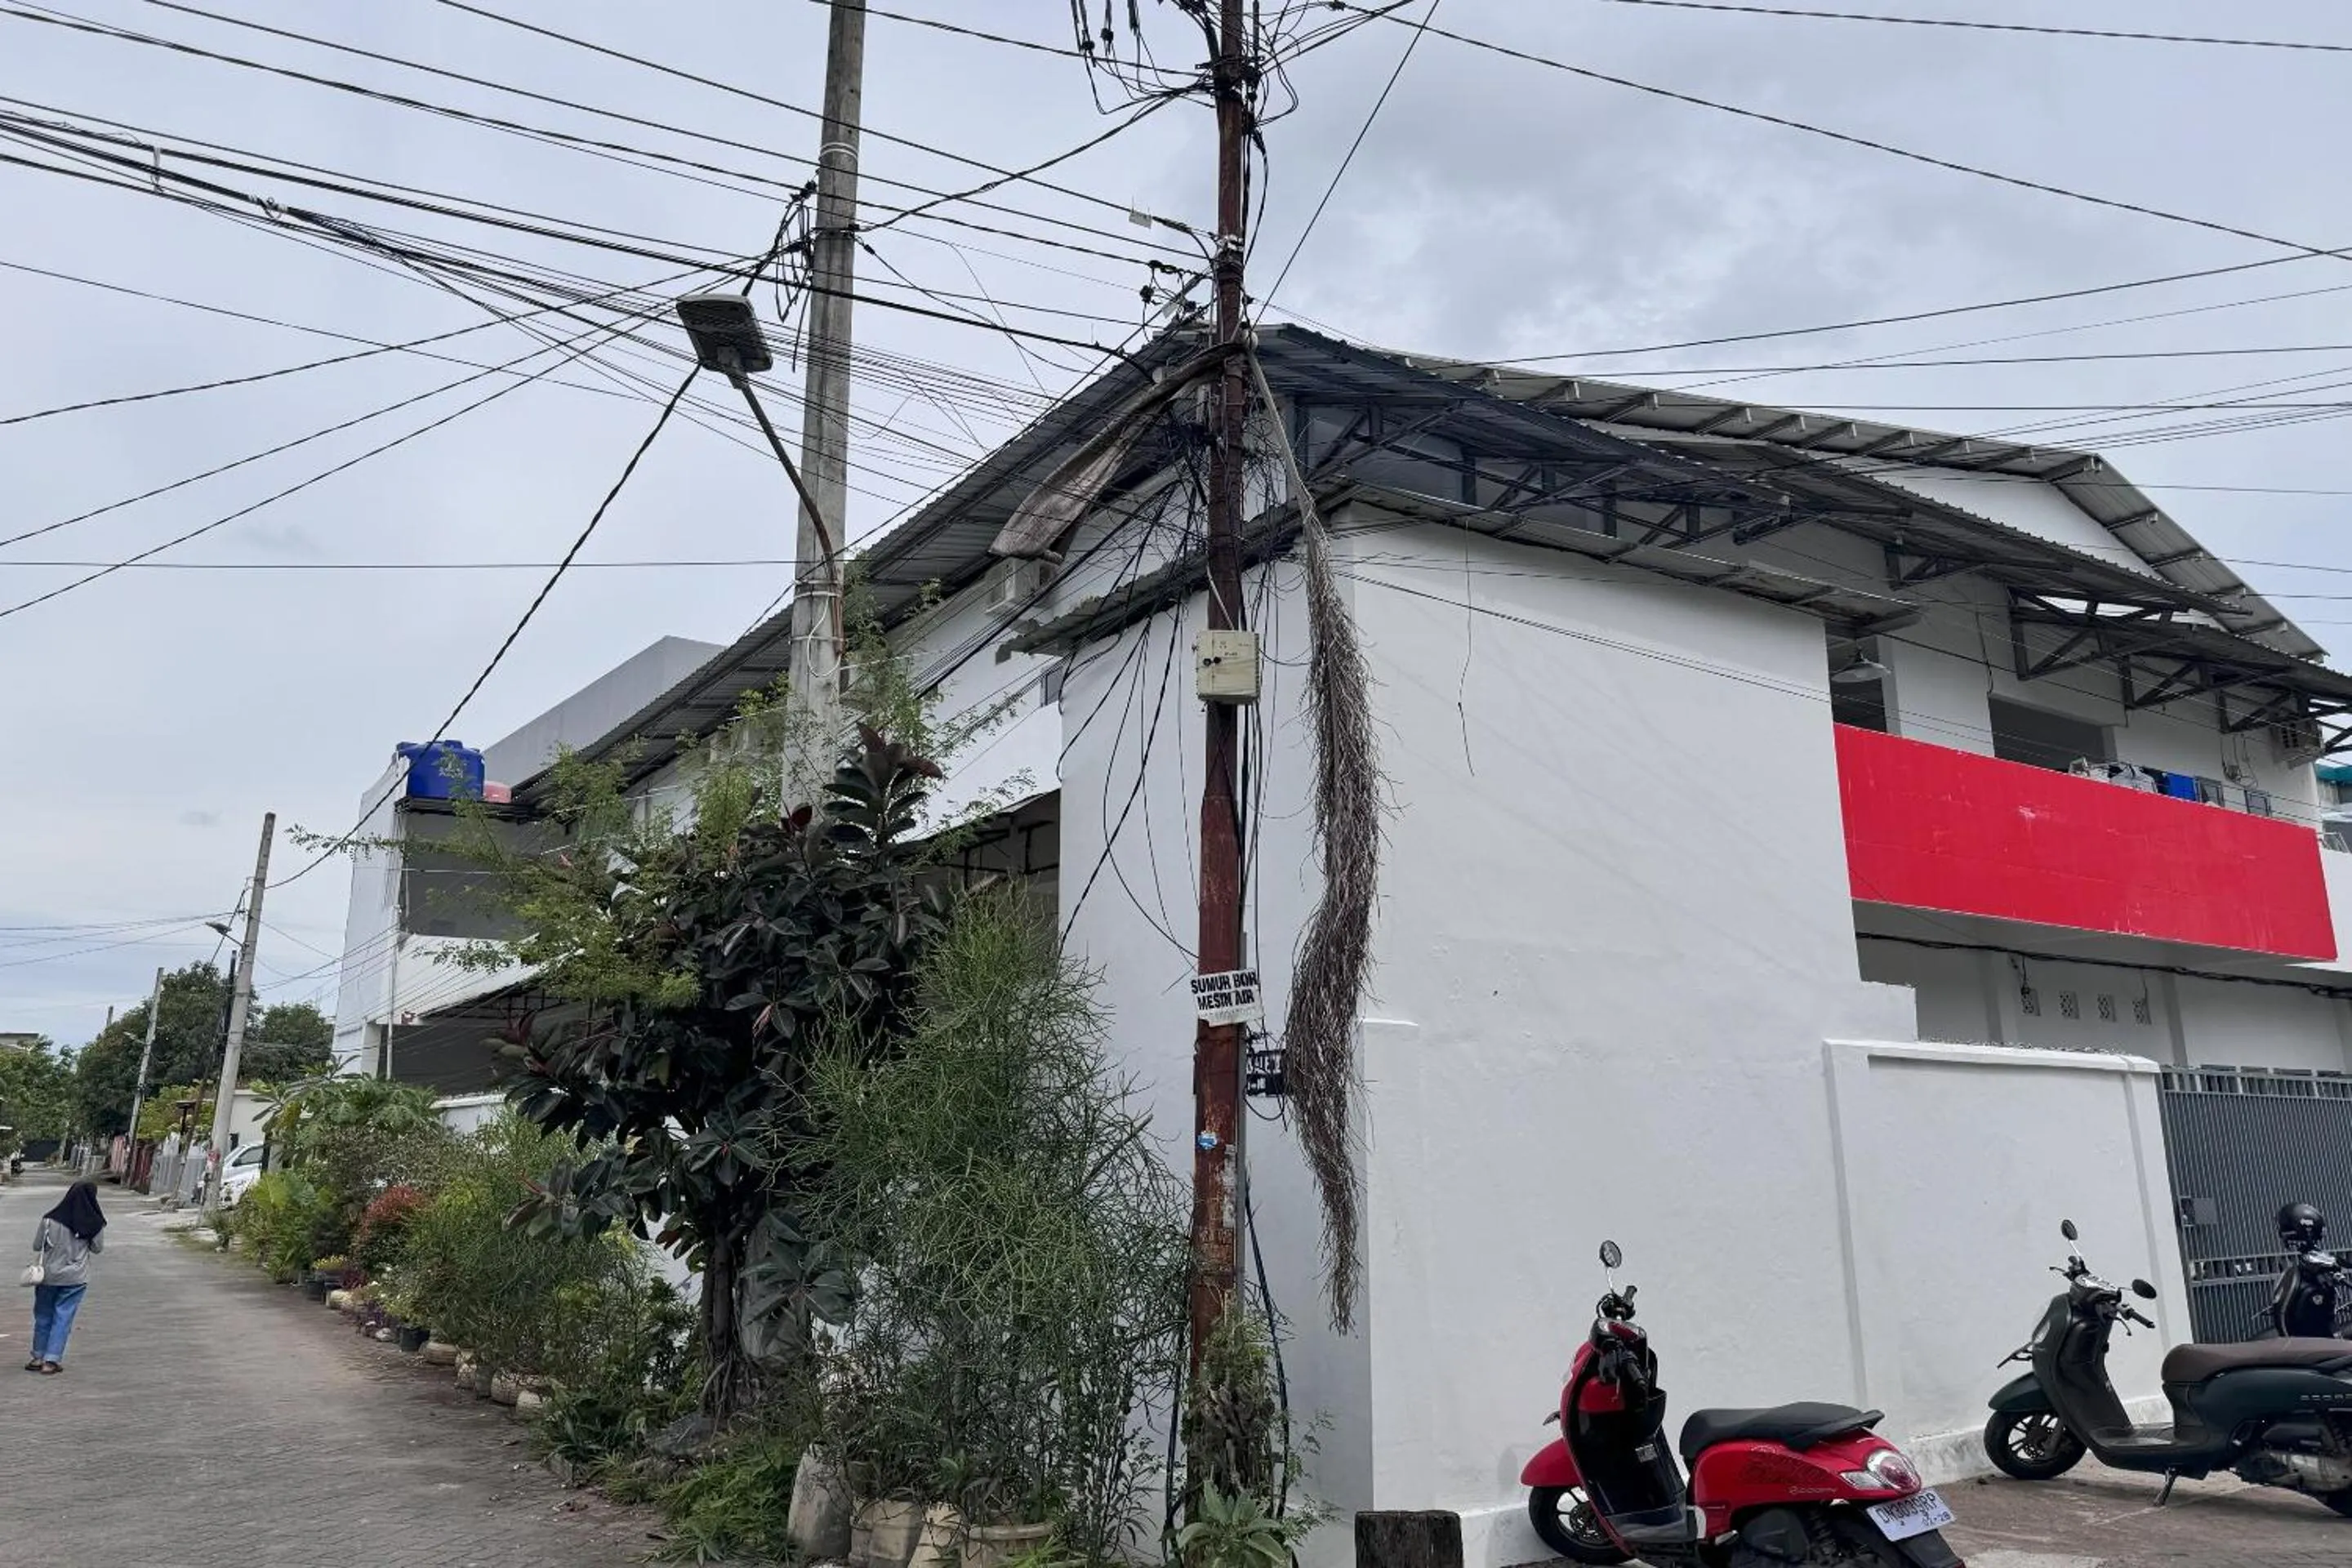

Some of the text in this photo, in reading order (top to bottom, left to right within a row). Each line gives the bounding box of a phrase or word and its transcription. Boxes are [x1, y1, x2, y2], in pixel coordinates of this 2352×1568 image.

[1191, 971, 1258, 994] SUMUR BOR
[1197, 989, 1255, 1010] MESIN AIR
